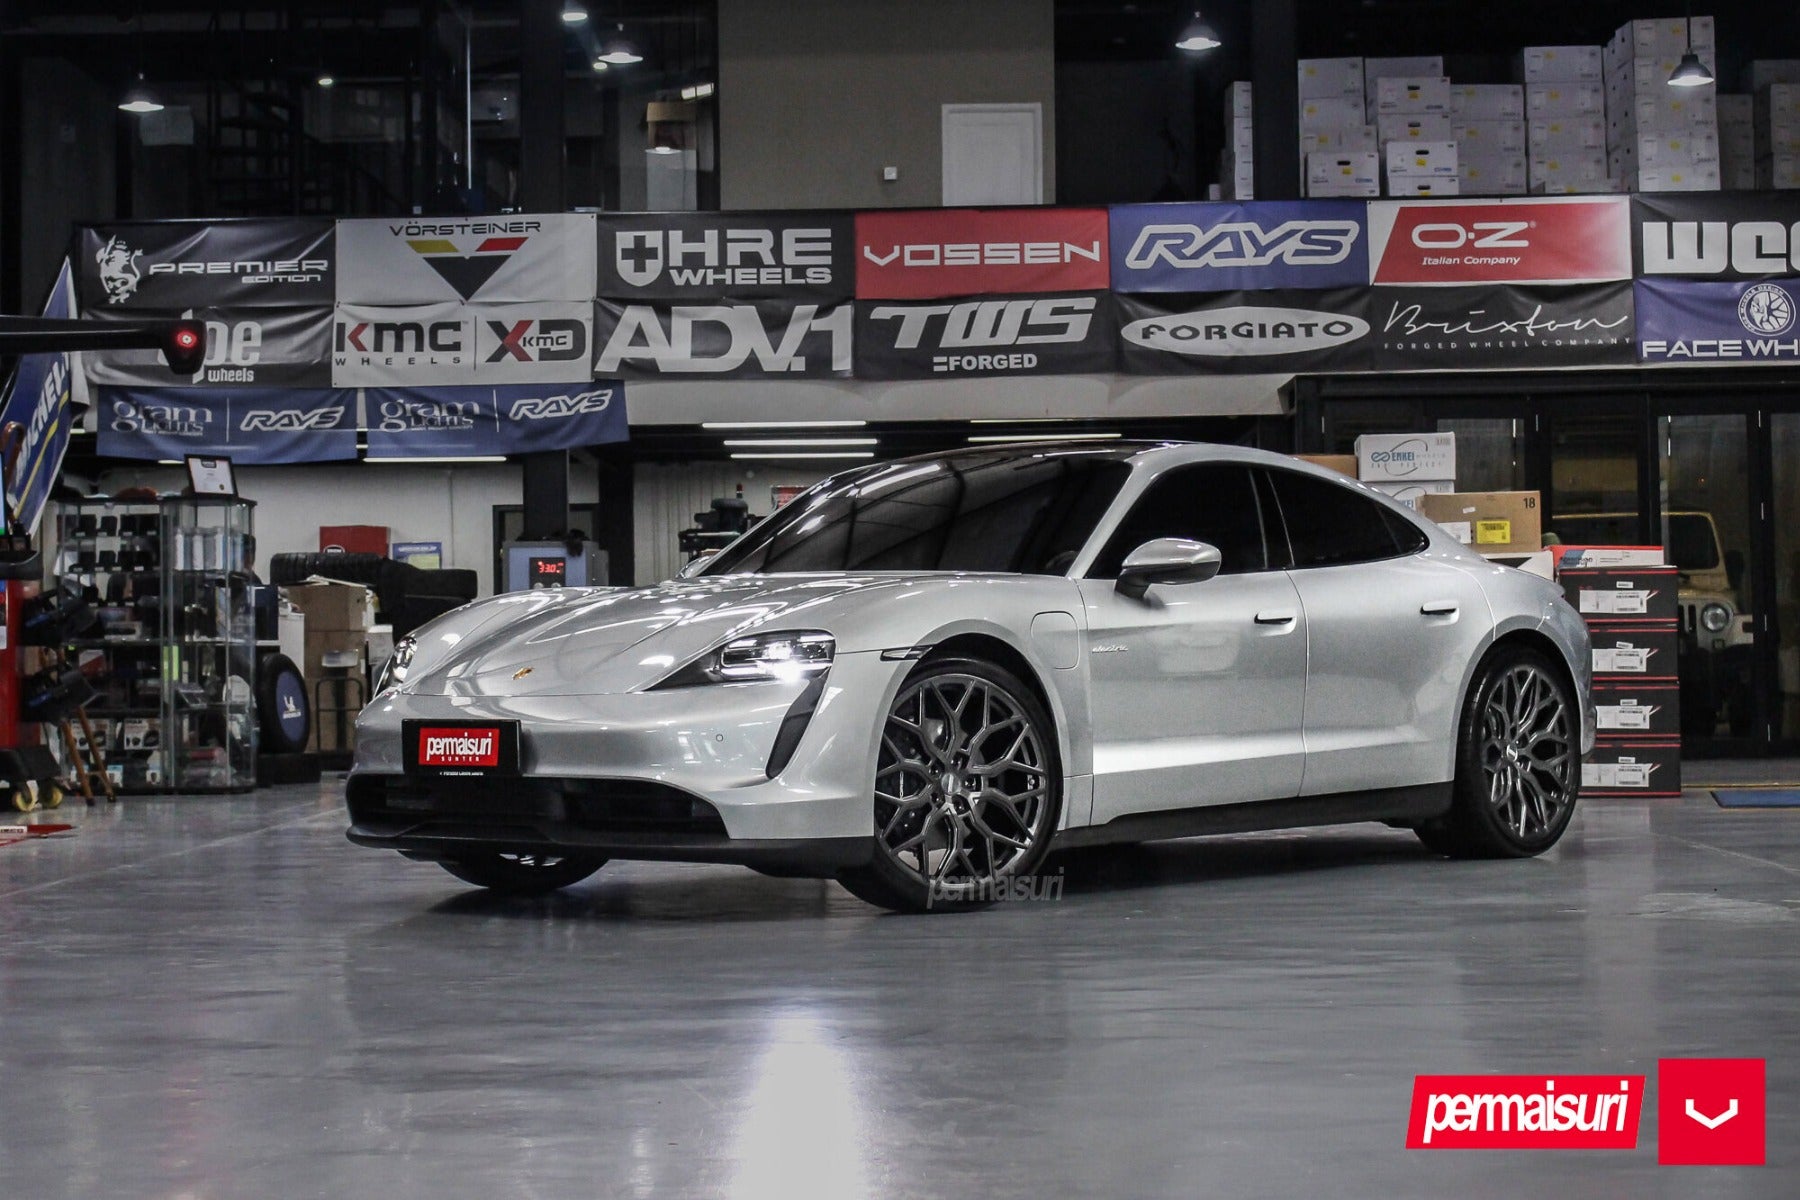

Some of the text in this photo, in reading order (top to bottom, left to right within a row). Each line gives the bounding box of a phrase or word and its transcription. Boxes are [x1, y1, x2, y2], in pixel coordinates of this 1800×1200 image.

[668, 229, 832, 266] HRE
[864, 240, 1100, 267] VOSSEN
[1125, 220, 1360, 269] RAYS
[149, 259, 328, 275] PREMIER
[1422, 255, 1521, 267] Italian Company
[241, 273, 321, 283] EDITION
[669, 266, 832, 286] WHEELS
[870, 297, 1096, 348] TWS
[1384, 301, 1629, 336] Brixton
[1141, 320, 1354, 340] FORGIATO
[1384, 336, 1631, 350] FORGED WHEEL COMPANY
[1642, 339, 1742, 358] FACE
[335, 356, 460, 366] WHEELS
[949, 353, 1037, 371] FORGED
[207, 367, 254, 382] wheels
[509, 389, 613, 421] RAYS
[111, 400, 212, 433] gram
[240, 405, 344, 432] RAYS
[380, 399, 480, 432] gram
[1523, 497, 1536, 509] 18
[426, 731, 492, 761] permaisuri
